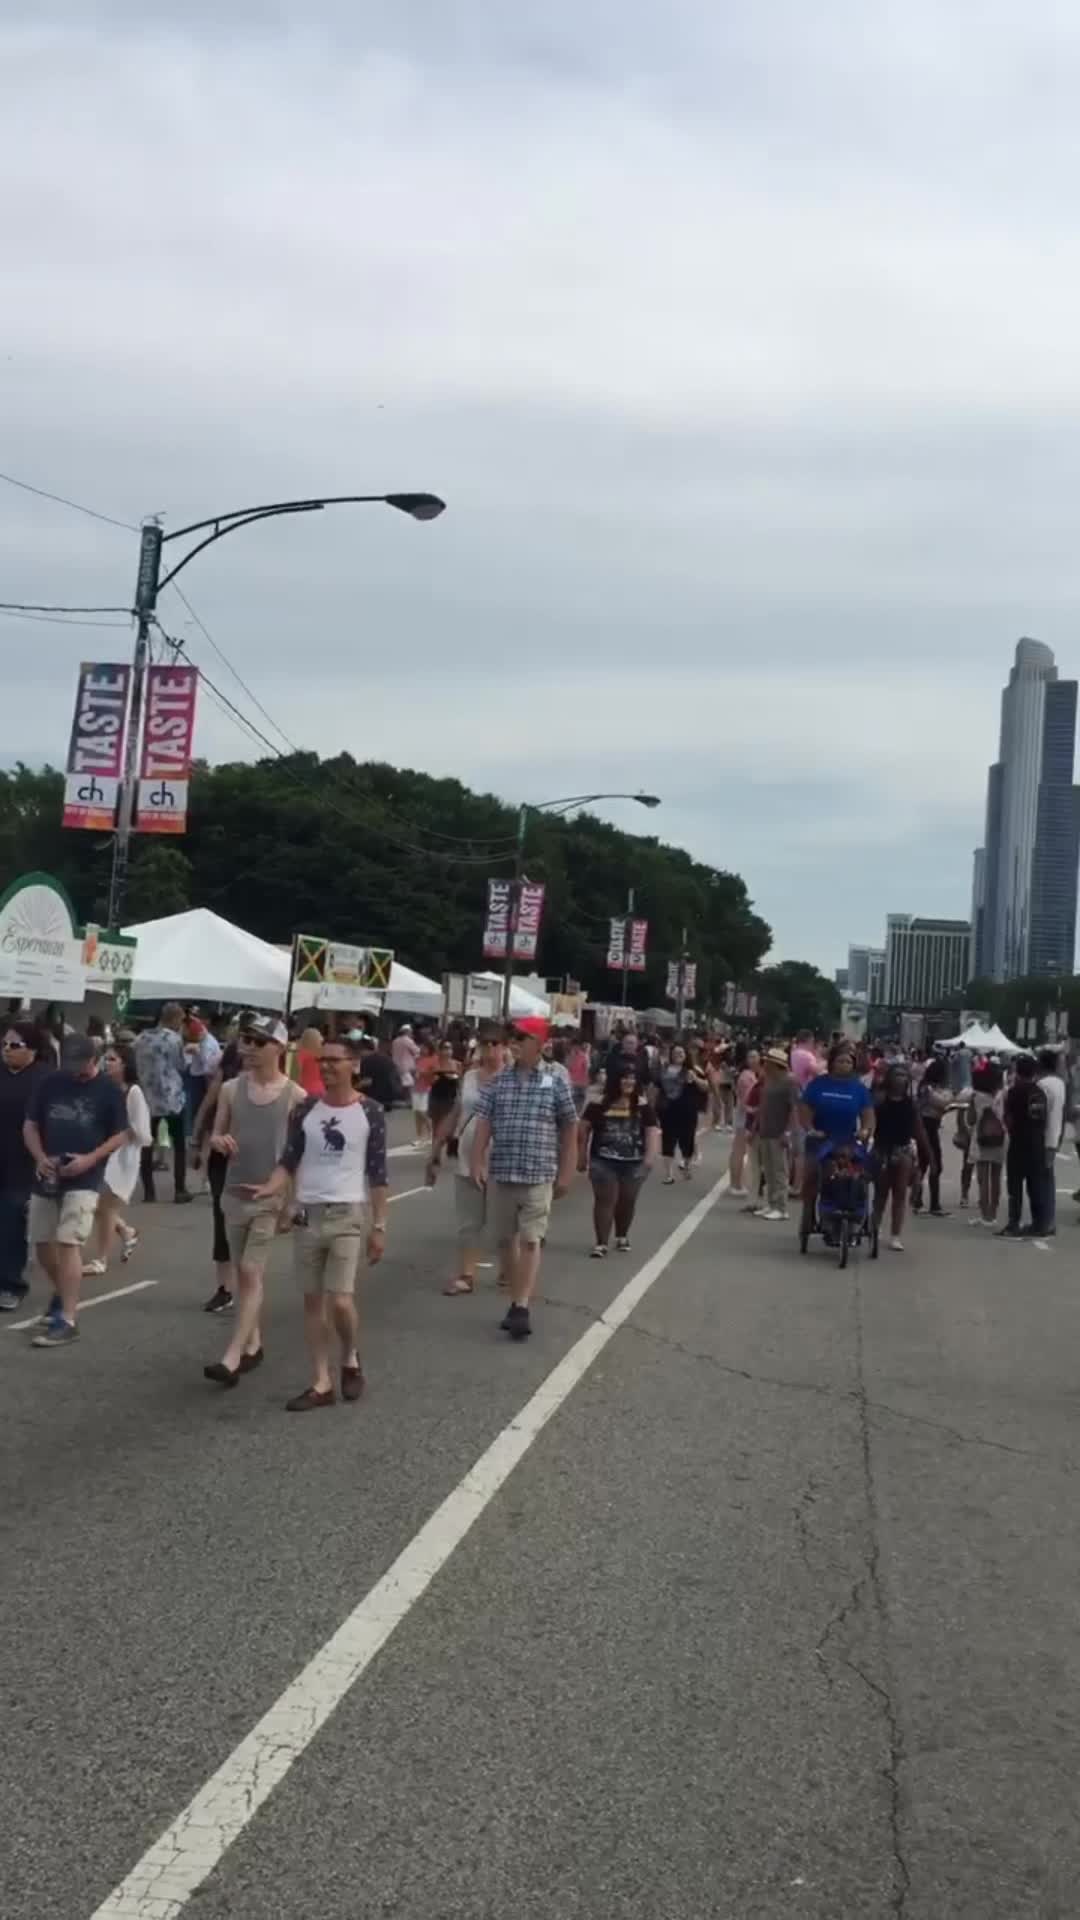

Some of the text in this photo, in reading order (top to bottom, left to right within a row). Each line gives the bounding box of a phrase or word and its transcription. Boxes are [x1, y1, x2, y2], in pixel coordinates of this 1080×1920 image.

[73, 673, 125, 771] TASTE
[145, 675, 192, 777] TASTE
[77, 777, 104, 801] ch
[150, 781, 174, 807] ch
[487, 884, 510, 932] TASTE
[518, 886, 542, 932] TASTE
